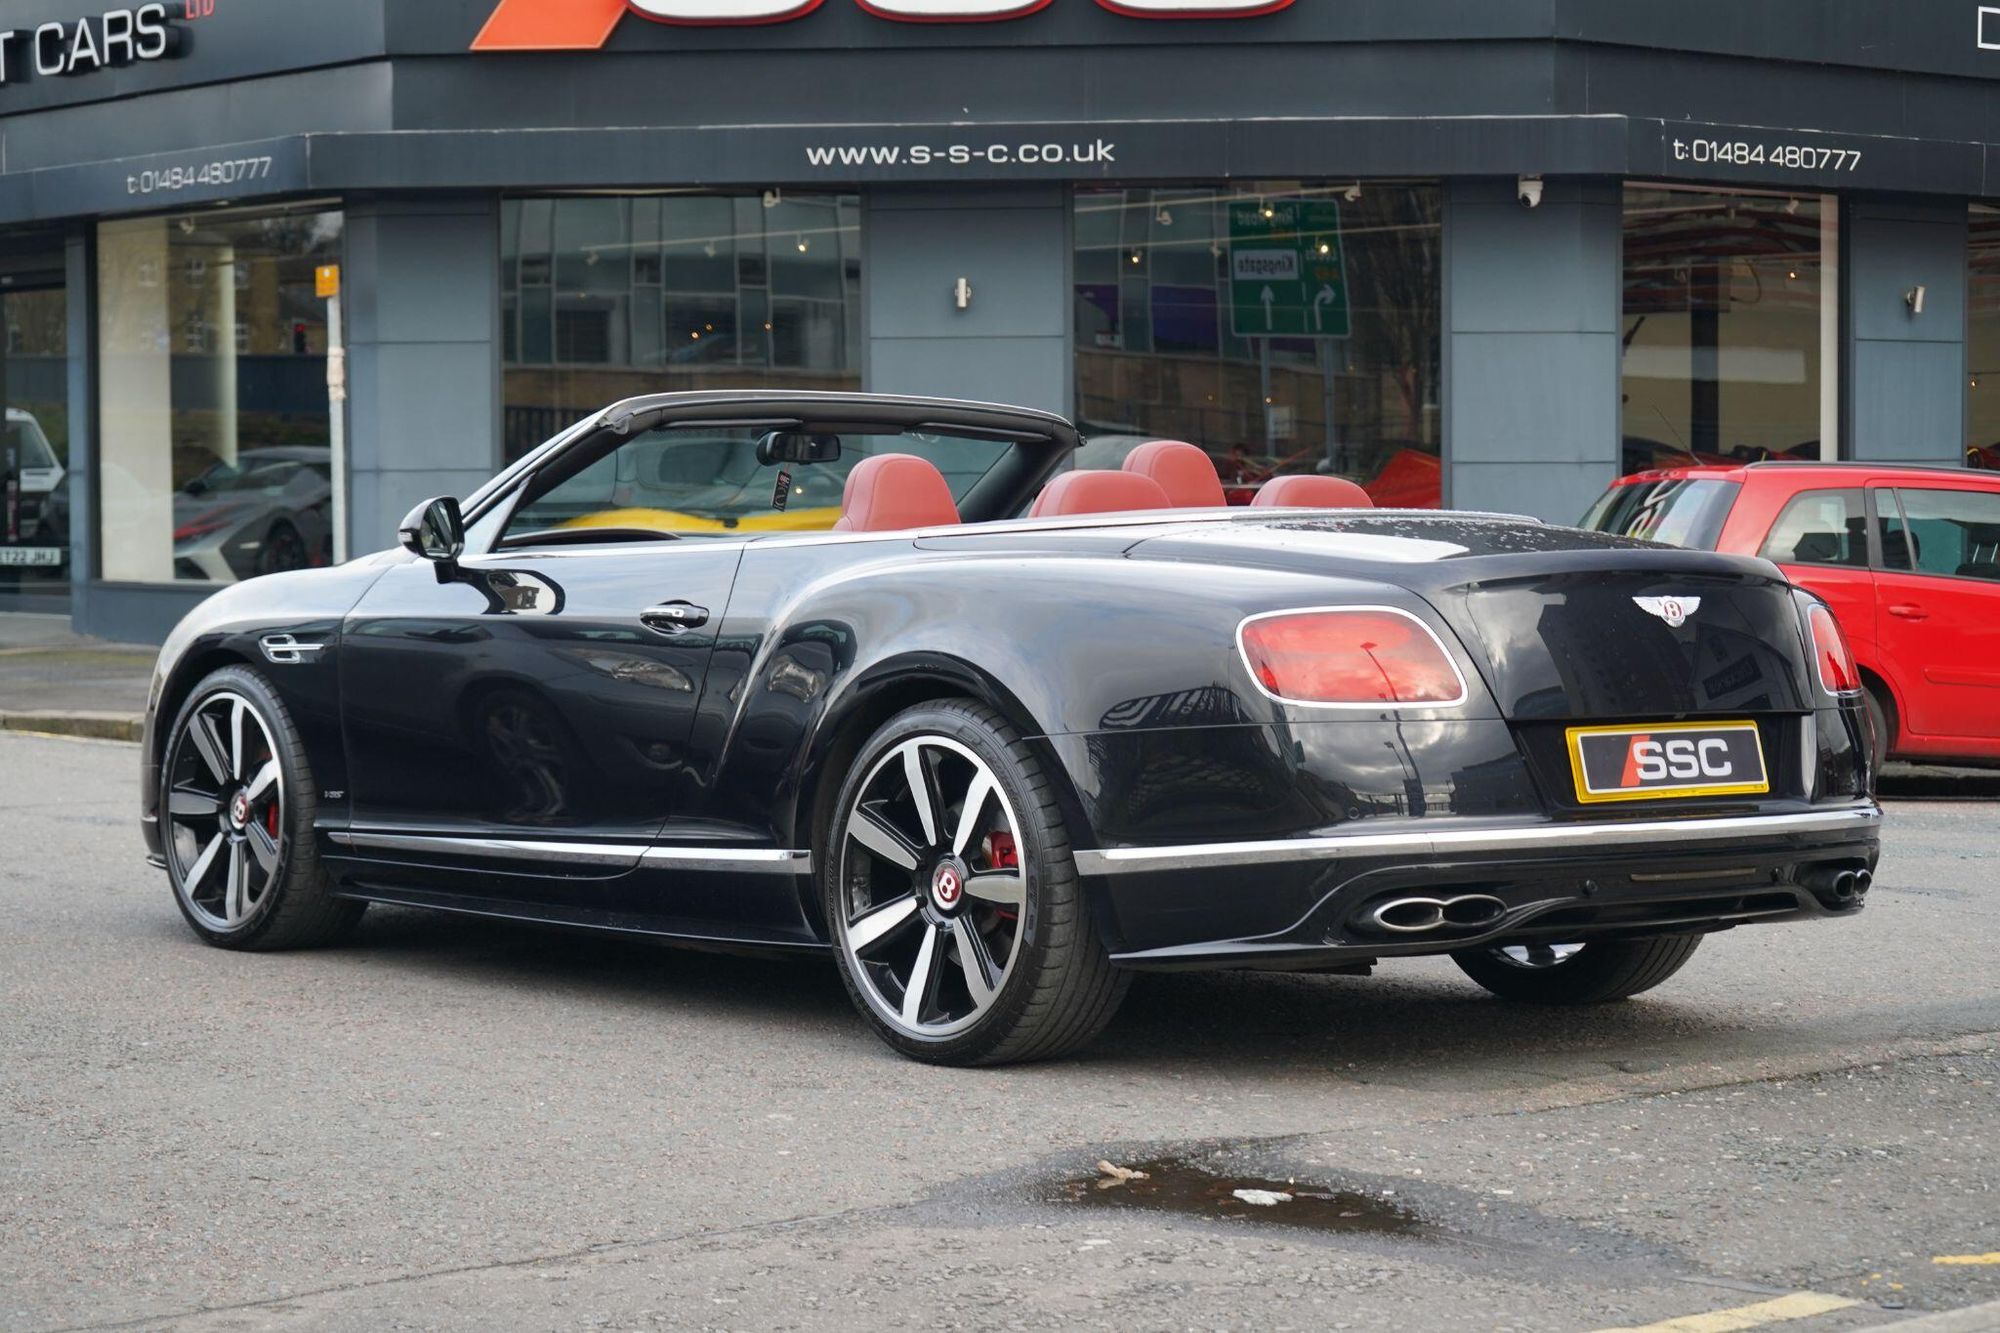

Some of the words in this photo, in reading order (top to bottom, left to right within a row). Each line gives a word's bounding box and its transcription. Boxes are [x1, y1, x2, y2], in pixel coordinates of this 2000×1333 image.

[35, 3, 166, 76] CARS
[806, 139, 1115, 165] www.s-s-c.co.uk
[1673, 138, 1765, 164] t:01484
[1769, 145, 1862, 171] 480777
[1632, 738, 1733, 780] SSC
